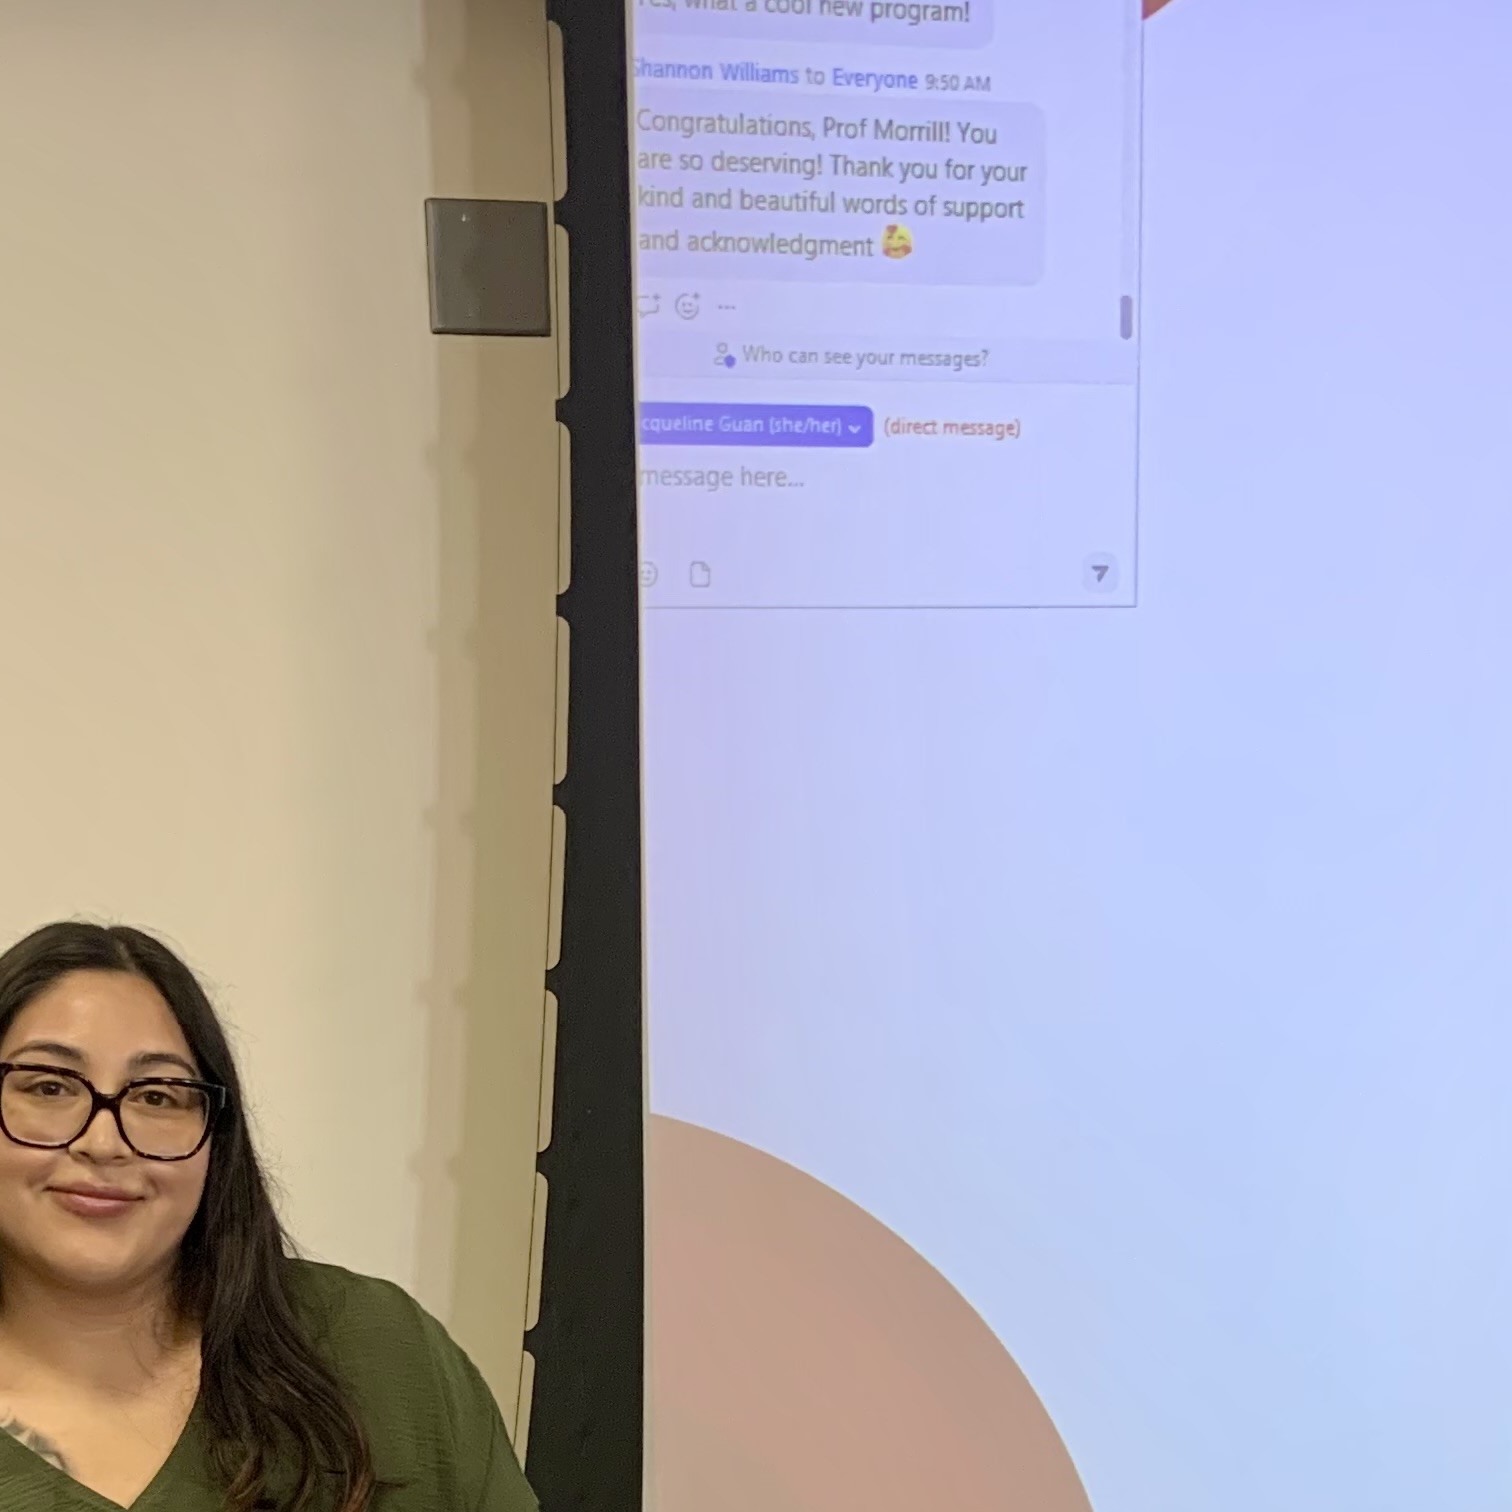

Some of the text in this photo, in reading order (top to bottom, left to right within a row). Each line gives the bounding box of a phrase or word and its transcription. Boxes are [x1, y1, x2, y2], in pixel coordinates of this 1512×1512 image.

[745, 0, 757, 12] a
[765, 0, 811, 14] cool
[819, 0, 863, 16] new
[871, 1, 970, 25] program!
[720, 61, 800, 84] Williams
[806, 67, 825, 85] to
[833, 67, 918, 92] Everyone
[925, 73, 960, 91] 9:50
[964, 75, 991, 91] AM
[637, 108, 997, 144] Congratulations, Prof Morrill! You
[638, 150, 1028, 186] are so deserving! Thank you for your
[638, 185, 1024, 222] kind and beautiful words of support
[639, 229, 874, 260] and acknowledgment
[742, 344, 988, 371] Who can see your messages?
[641, 415, 714, 433] cqueline
[719, 416, 764, 433] Guan
[884, 417, 1020, 441] (direct message)
[640, 465, 804, 492] message here...
